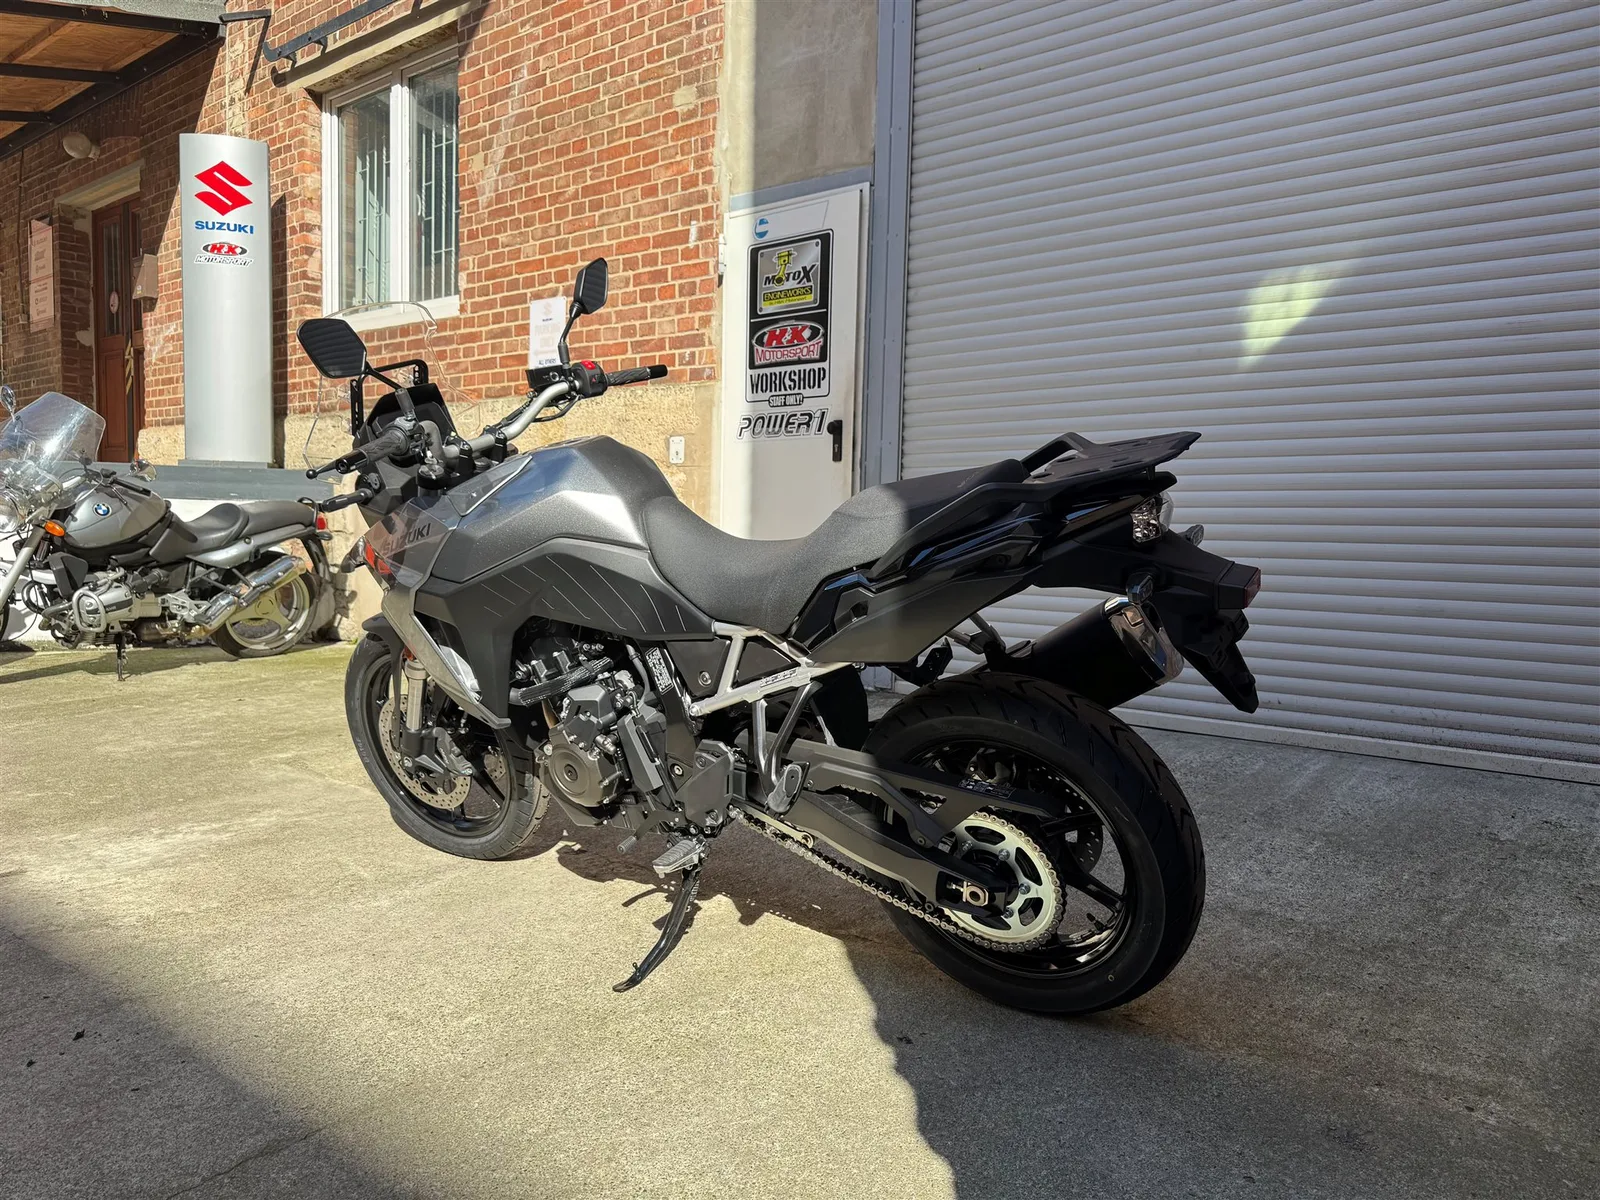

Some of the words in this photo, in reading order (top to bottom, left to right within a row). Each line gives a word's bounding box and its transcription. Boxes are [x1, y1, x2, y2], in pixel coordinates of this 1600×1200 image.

[194, 220, 254, 235] SUZUKI
[195, 255, 252, 266] MOTORSPORT
[764, 286, 812, 301] ENGINEWORKS
[755, 340, 822, 363] MOTORSPORT
[750, 367, 826, 394] WORKSHOP
[769, 395, 786, 406] STAFF
[786, 394, 803, 405] ONLY!
[738, 409, 827, 438] POWER1
